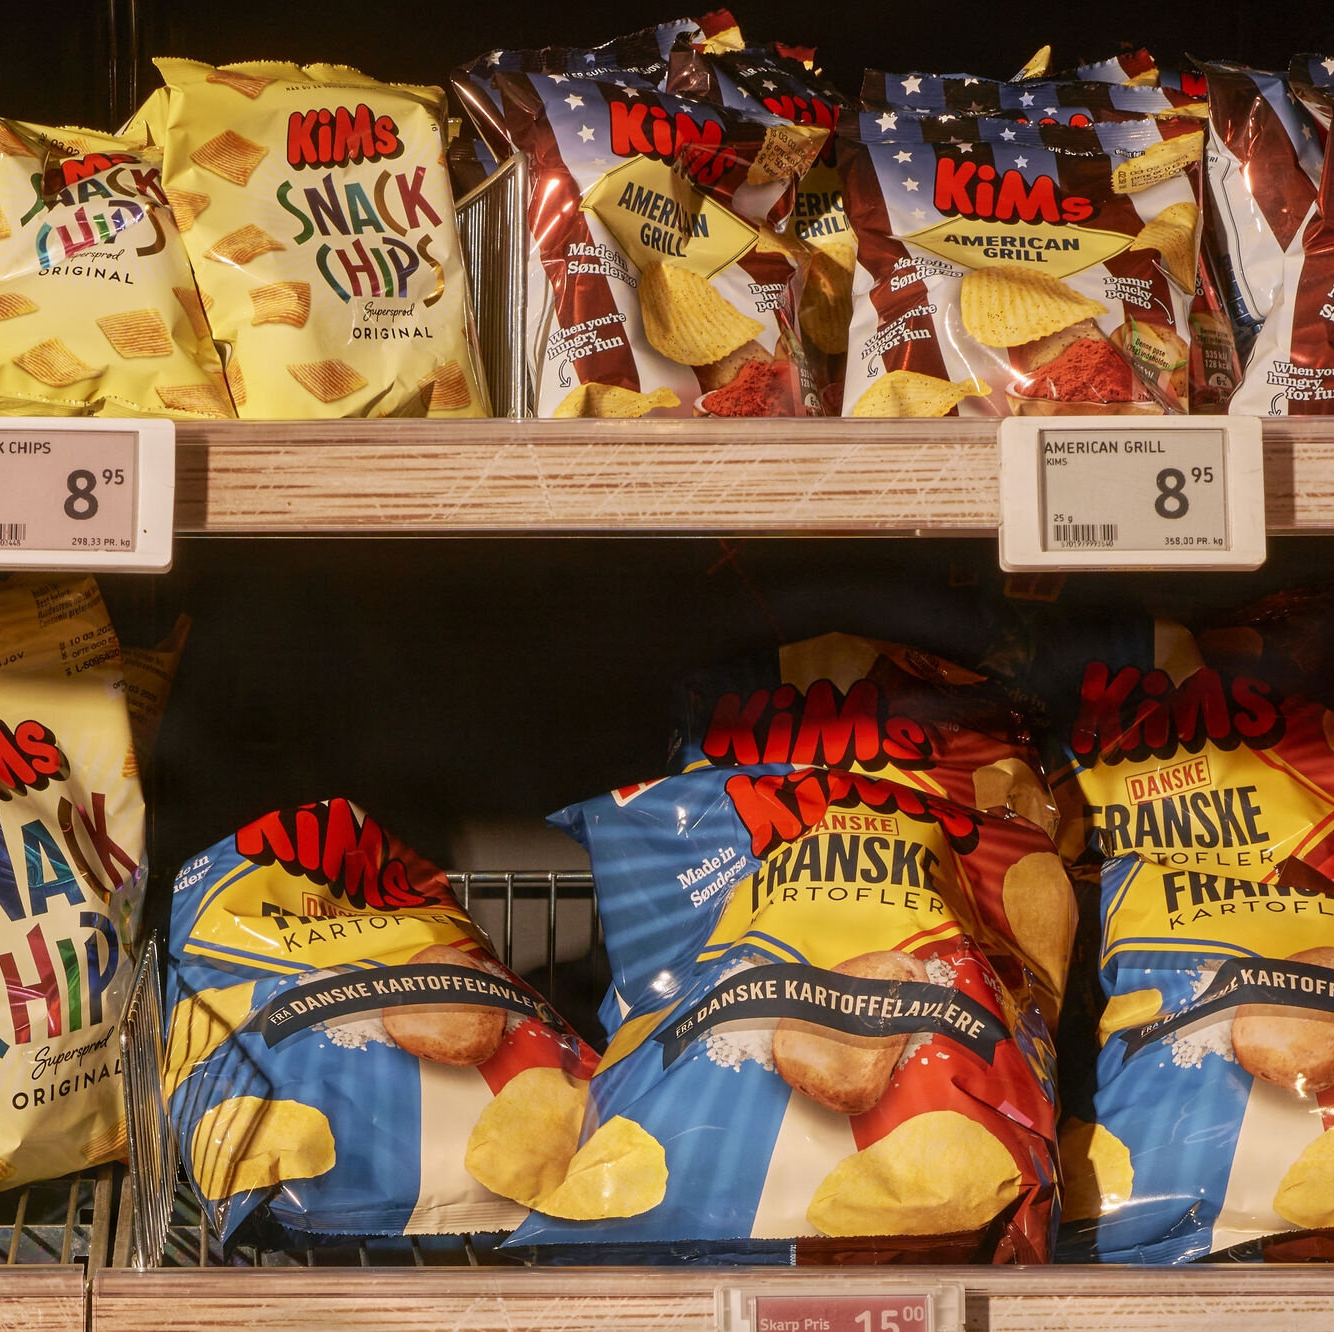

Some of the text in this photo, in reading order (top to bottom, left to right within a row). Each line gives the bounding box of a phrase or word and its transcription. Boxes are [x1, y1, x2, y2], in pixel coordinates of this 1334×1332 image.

[287, 104, 401, 167] KiMs
[277, 167, 442, 245] SNACK
[934, 157, 1094, 222] KiMs
[640, 222, 687, 258] GRILL
[944, 234, 1079, 251] AMERICAN
[983, 248, 1048, 262] GRILL
[39, 266, 134, 284] ORIGINAL
[316, 235, 445, 306] CHIPS
[353, 327, 433, 340] ORIGINAL
[9, 442, 51, 454] CHIPS
[1044, 442, 1165, 454] AMERICAN GRILL
[1046, 458, 1067, 466] KIMS
[64, 469, 124, 519] 8 95
[1155, 468, 1213, 519] 8 95
[1165, 537, 1193, 545] 358,00
[1214, 537, 1223, 547] kg
[1131, 761, 1206, 800] DANSKE
[752, 834, 939, 914] FRANSKE
[270, 983, 368, 1025] FRA DANSKE
[760, 1319, 800, 1332] Skarp
[805, 1318, 830, 1330] Pris
[903, 1306, 924, 1322] 00
